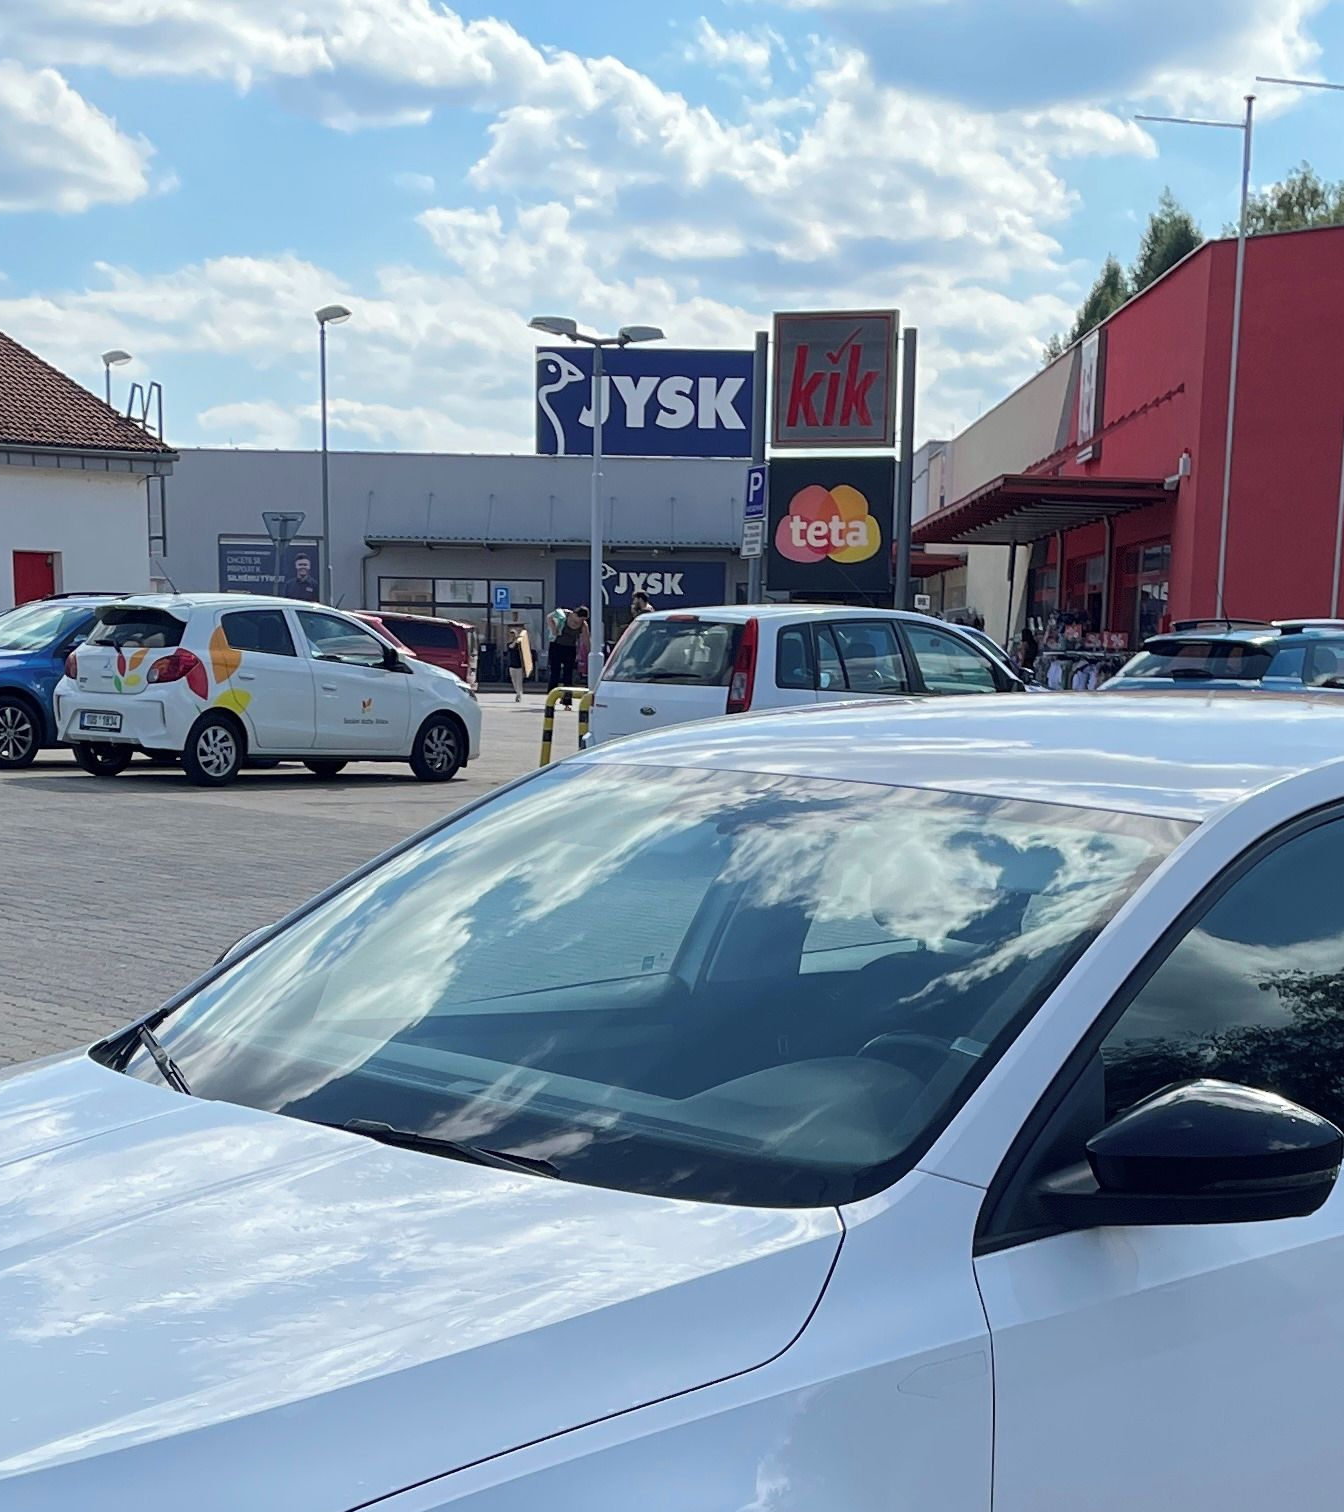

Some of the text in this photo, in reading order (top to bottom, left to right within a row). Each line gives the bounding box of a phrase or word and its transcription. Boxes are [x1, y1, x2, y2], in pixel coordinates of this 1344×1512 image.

[786, 327, 880, 427] kik
[578, 375, 746, 429] JYSK
[749, 472, 763, 502] P
[789, 515, 869, 548] teta
[497, 589, 506, 603] P
[614, 572, 684, 595] JYSK
